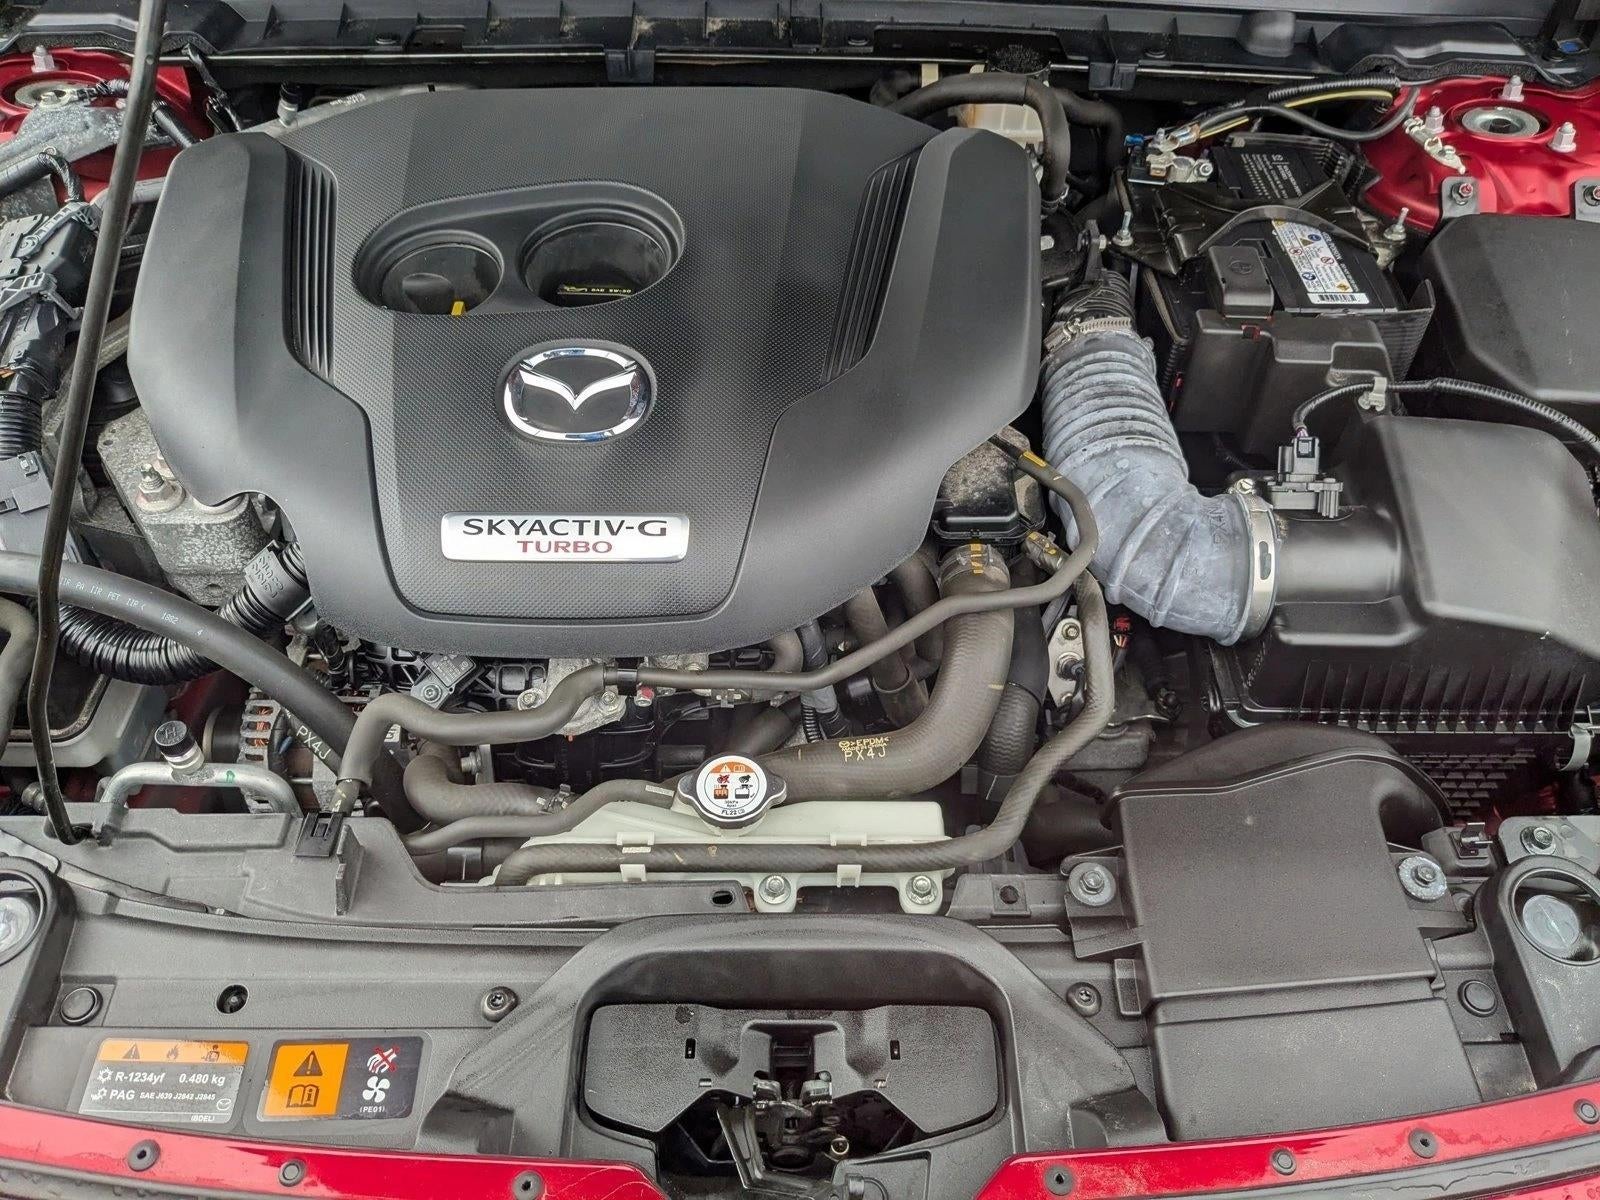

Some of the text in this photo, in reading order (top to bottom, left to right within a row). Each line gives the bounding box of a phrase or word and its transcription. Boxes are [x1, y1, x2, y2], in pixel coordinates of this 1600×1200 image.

[462, 518, 668, 537] SKYACTIV-G
[517, 541, 613, 553] TURBO
[296, 725, 331, 760] PX4J
[844, 747, 886, 762] PX4J
[115, 1071, 226, 1087] R-1234yf 0.480 kg
[109, 1089, 135, 1101] PAG
[139, 1091, 156, 1100] SAE
[156, 1091, 173, 1100] J639
